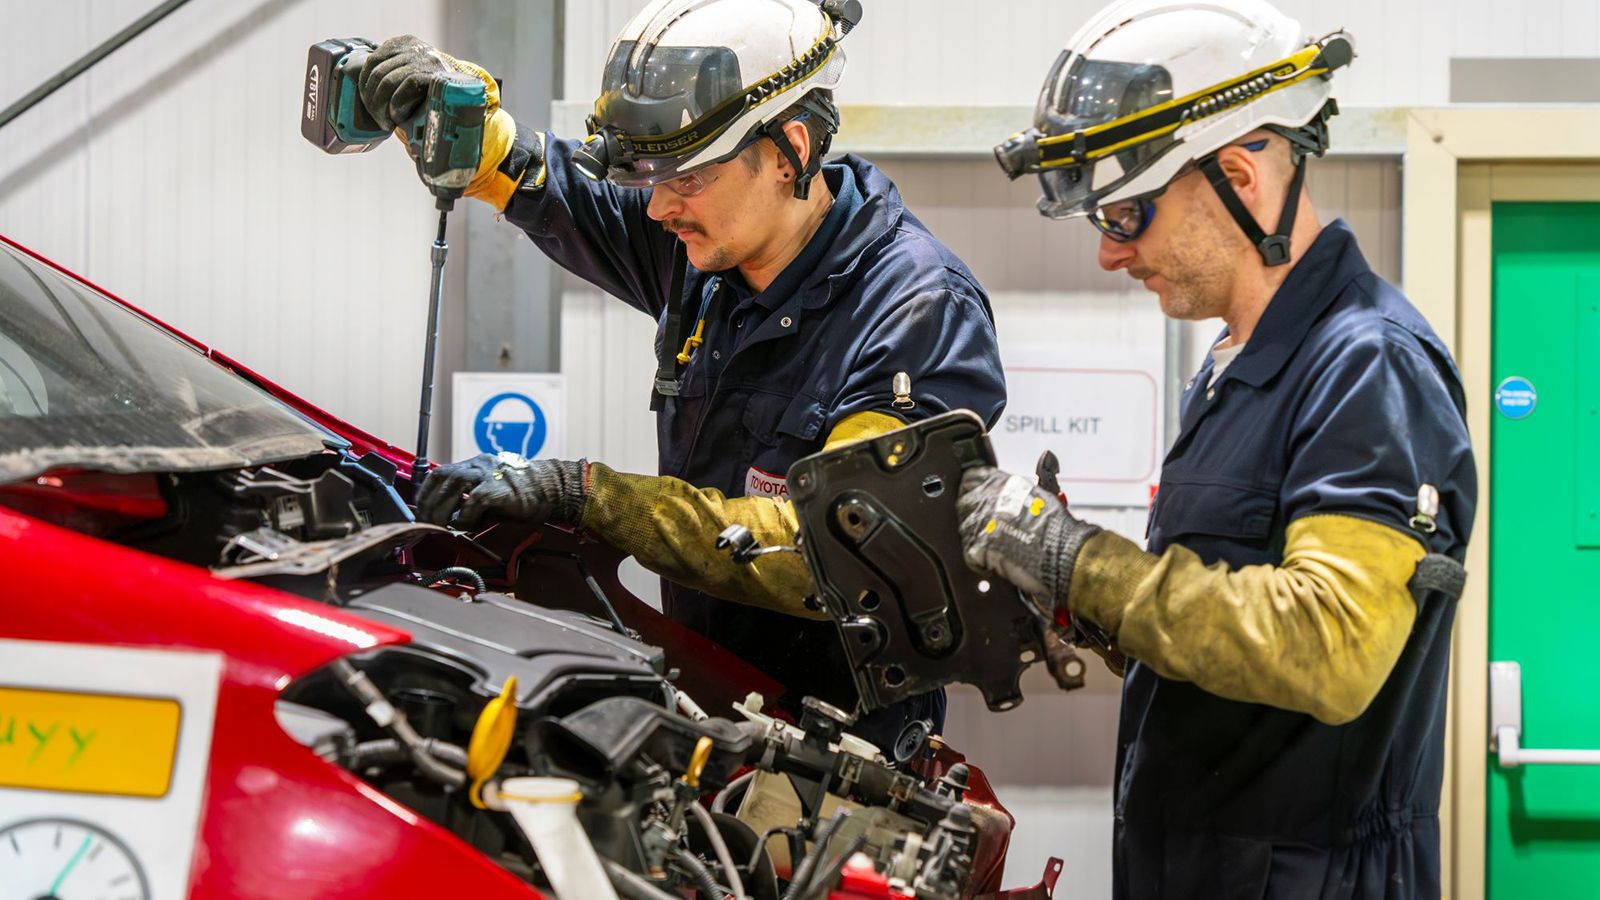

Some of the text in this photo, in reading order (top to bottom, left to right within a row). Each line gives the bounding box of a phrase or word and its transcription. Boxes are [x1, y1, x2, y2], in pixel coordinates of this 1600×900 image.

[1005, 414, 1103, 434] SPILL KIT
[751, 475, 789, 495] TOYOTA
